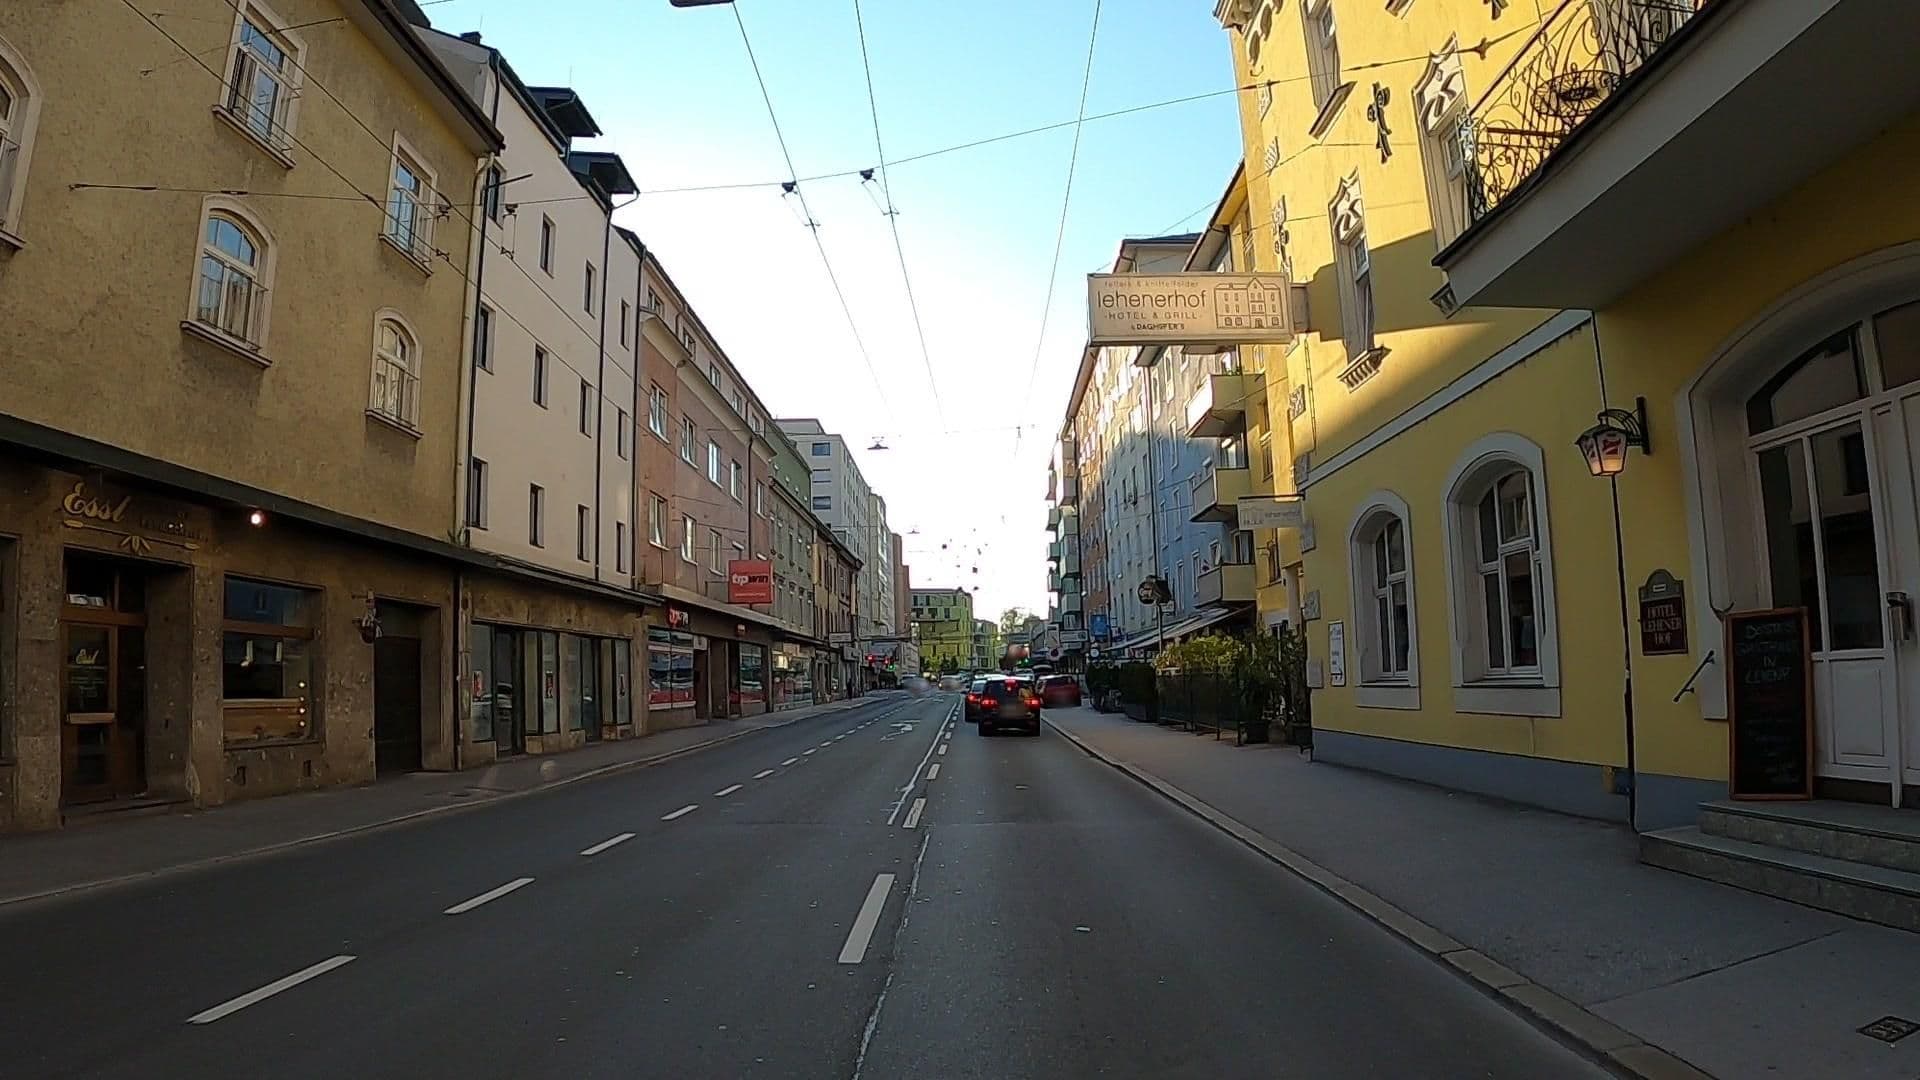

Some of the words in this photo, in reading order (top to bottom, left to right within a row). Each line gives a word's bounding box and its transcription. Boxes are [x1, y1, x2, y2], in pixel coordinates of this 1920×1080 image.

[1097, 289, 1206, 308] lehenerhof
[1647, 604, 1676, 618] HOTEL
[1643, 617, 1682, 632] LEHENER
